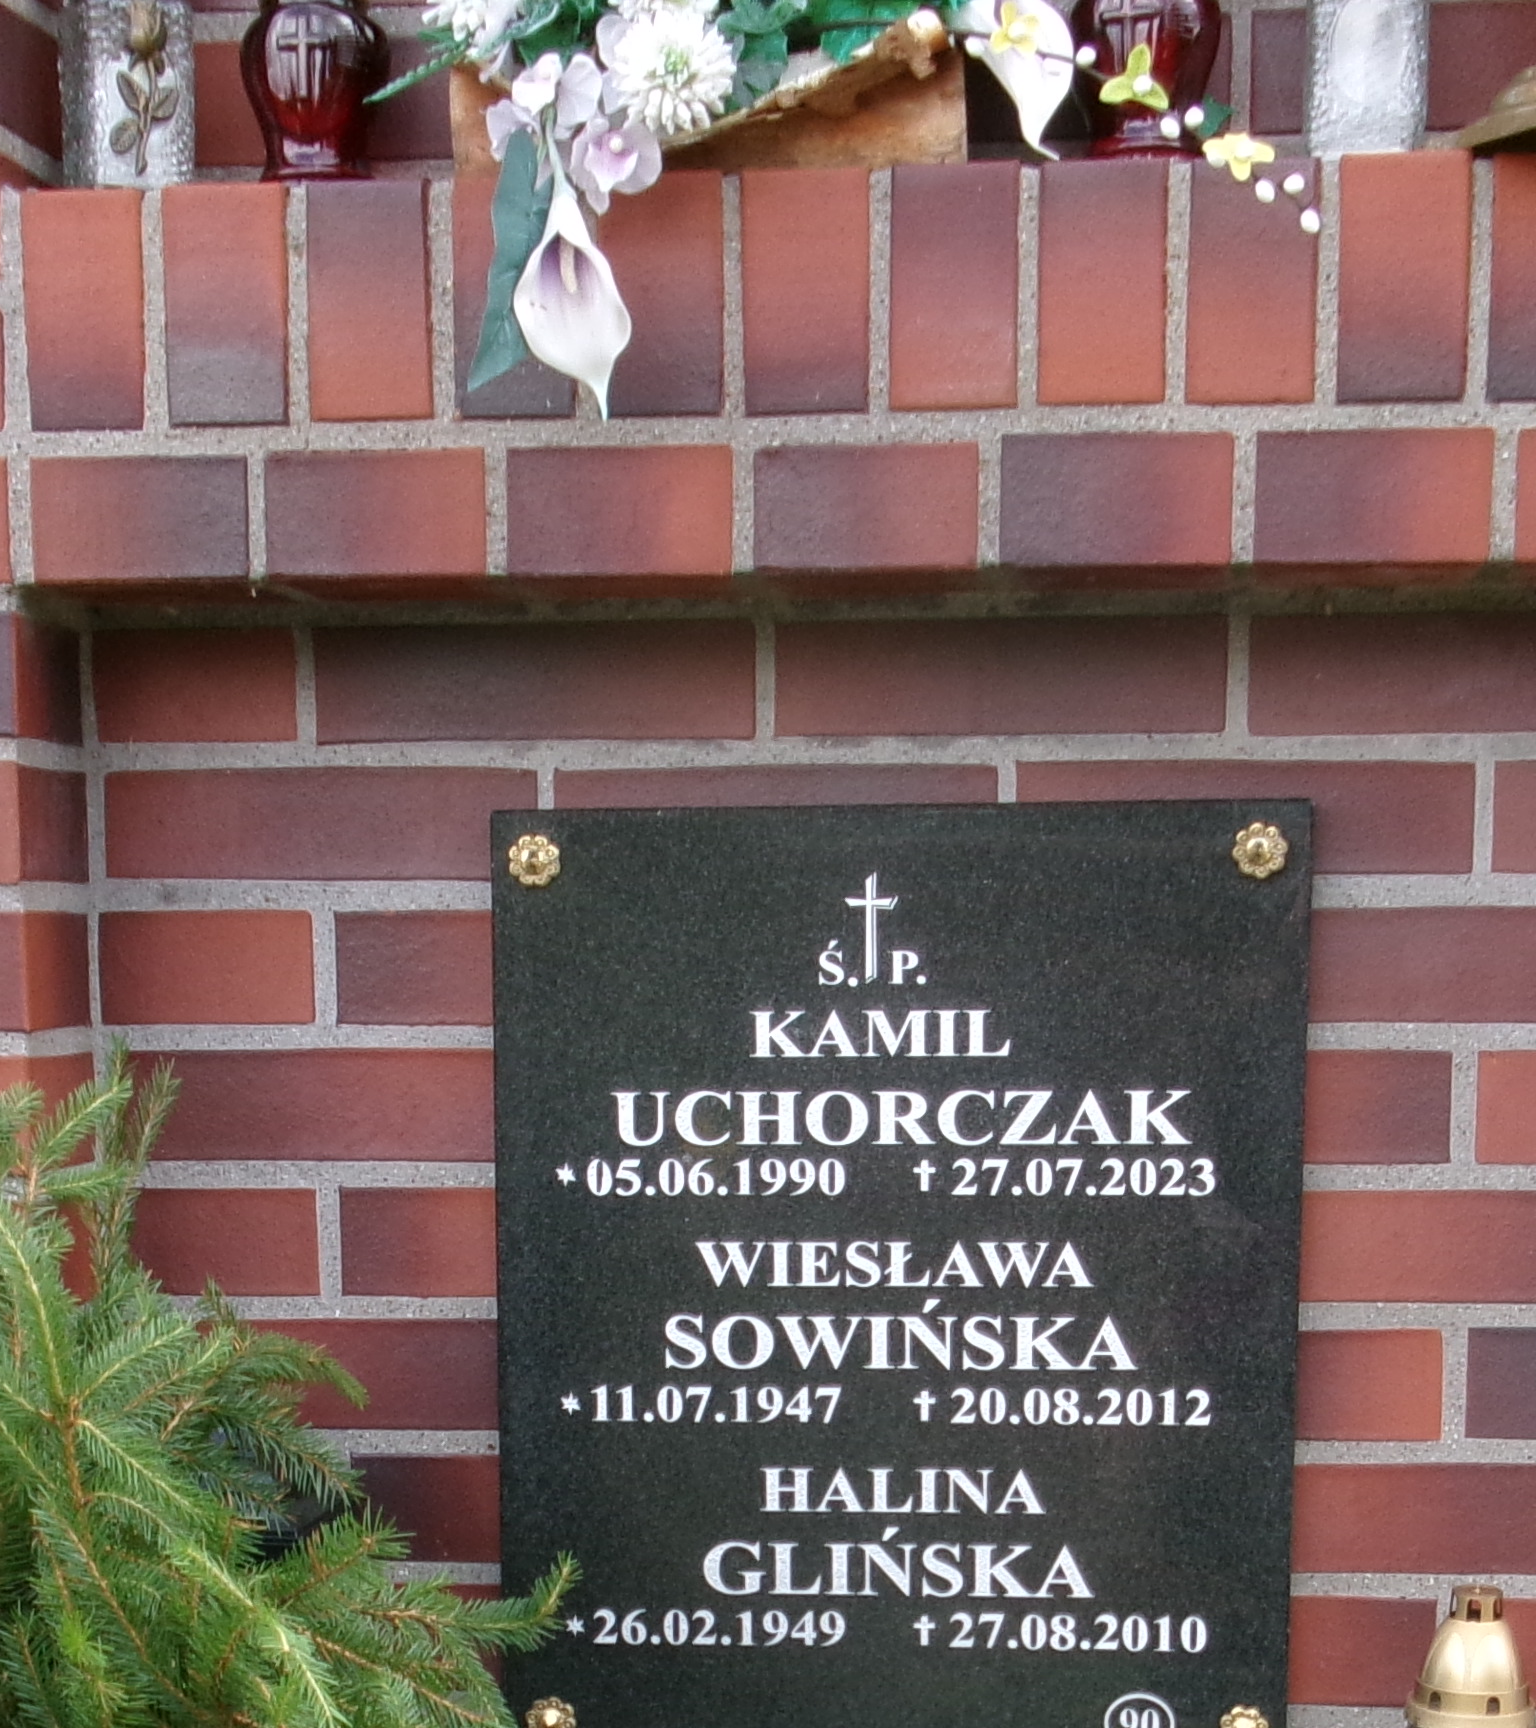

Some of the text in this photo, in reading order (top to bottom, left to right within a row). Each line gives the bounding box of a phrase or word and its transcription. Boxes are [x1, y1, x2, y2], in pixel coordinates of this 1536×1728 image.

[749, 1007, 1012, 1060] KAMIL
[611, 1087, 1194, 1148] UCHORCZAK
[586, 1155, 1218, 1199] 05.06.1990 27.07.2023
[694, 1239, 1096, 1290] WIESŁAWA
[664, 1298, 1140, 1373] SOWIŃSKA
[591, 1384, 1213, 1428] 11.07.1947 20.08.2012
[760, 1466, 1048, 1516] HALINA
[702, 1526, 1097, 1601] GLIŃSKA
[593, 1608, 1209, 1656] 26.02.1949 27.08.2010
